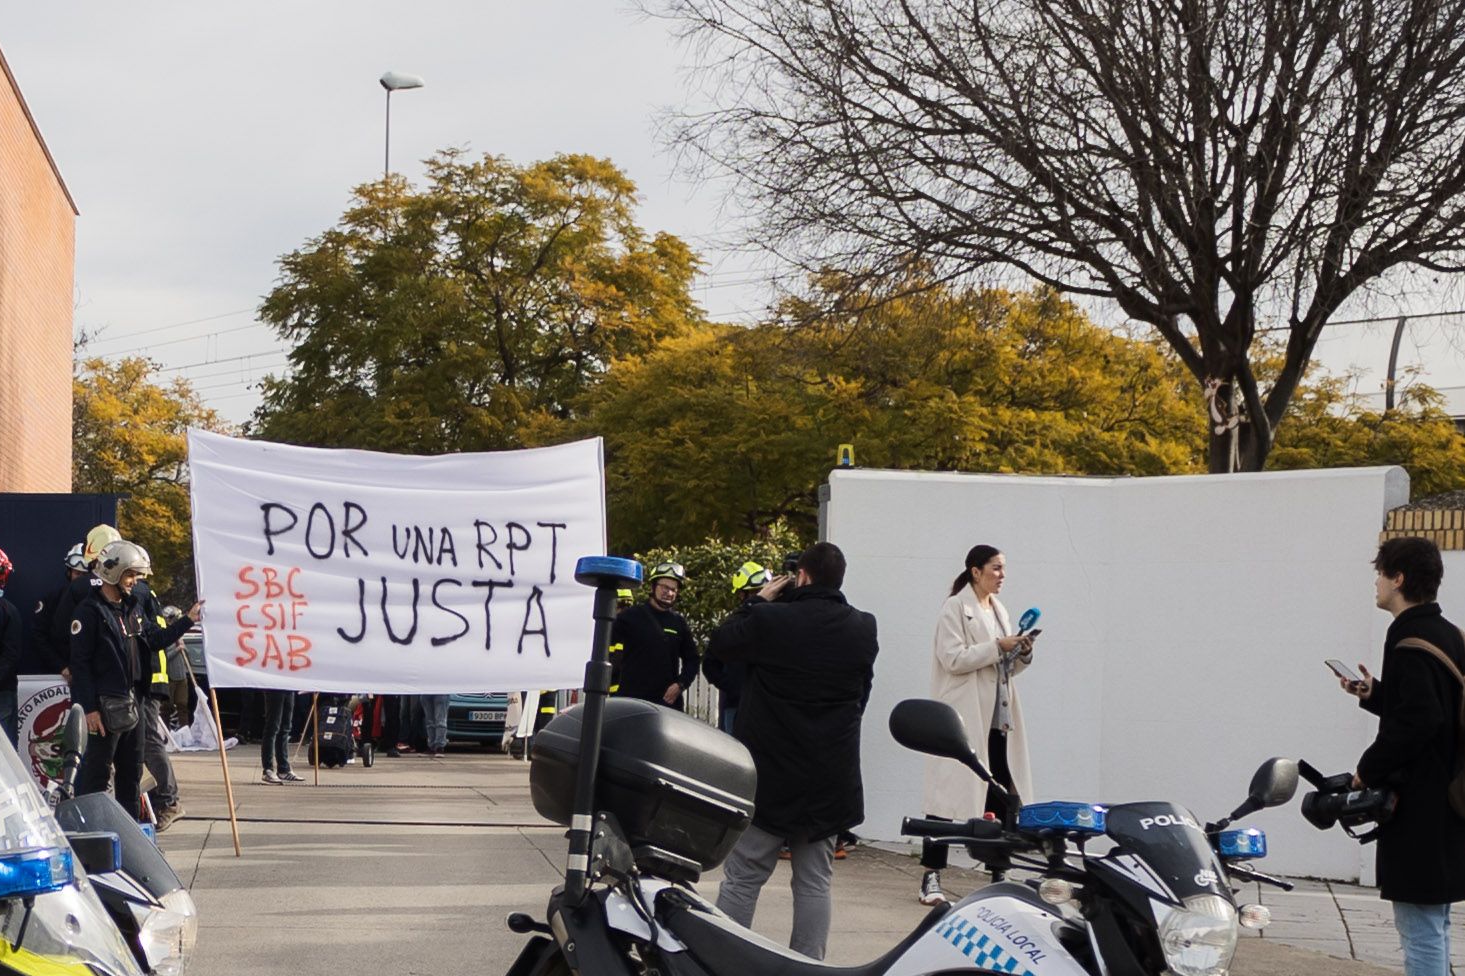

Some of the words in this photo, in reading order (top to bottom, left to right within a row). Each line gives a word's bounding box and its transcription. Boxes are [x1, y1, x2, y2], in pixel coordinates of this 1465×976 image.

[259, 501, 369, 560] POR
[392, 523, 458, 567] UNA
[473, 519, 567, 584] RPT
[90, 578, 104, 587] BO
[234, 566, 307, 600] SBC
[236, 601, 309, 631] CSIF
[337, 576, 551, 657] JUSTA
[235, 631, 313, 671] SAB
[33, 686, 70, 707] ANDAL
[1006, 930, 1047, 965] LOCAL
